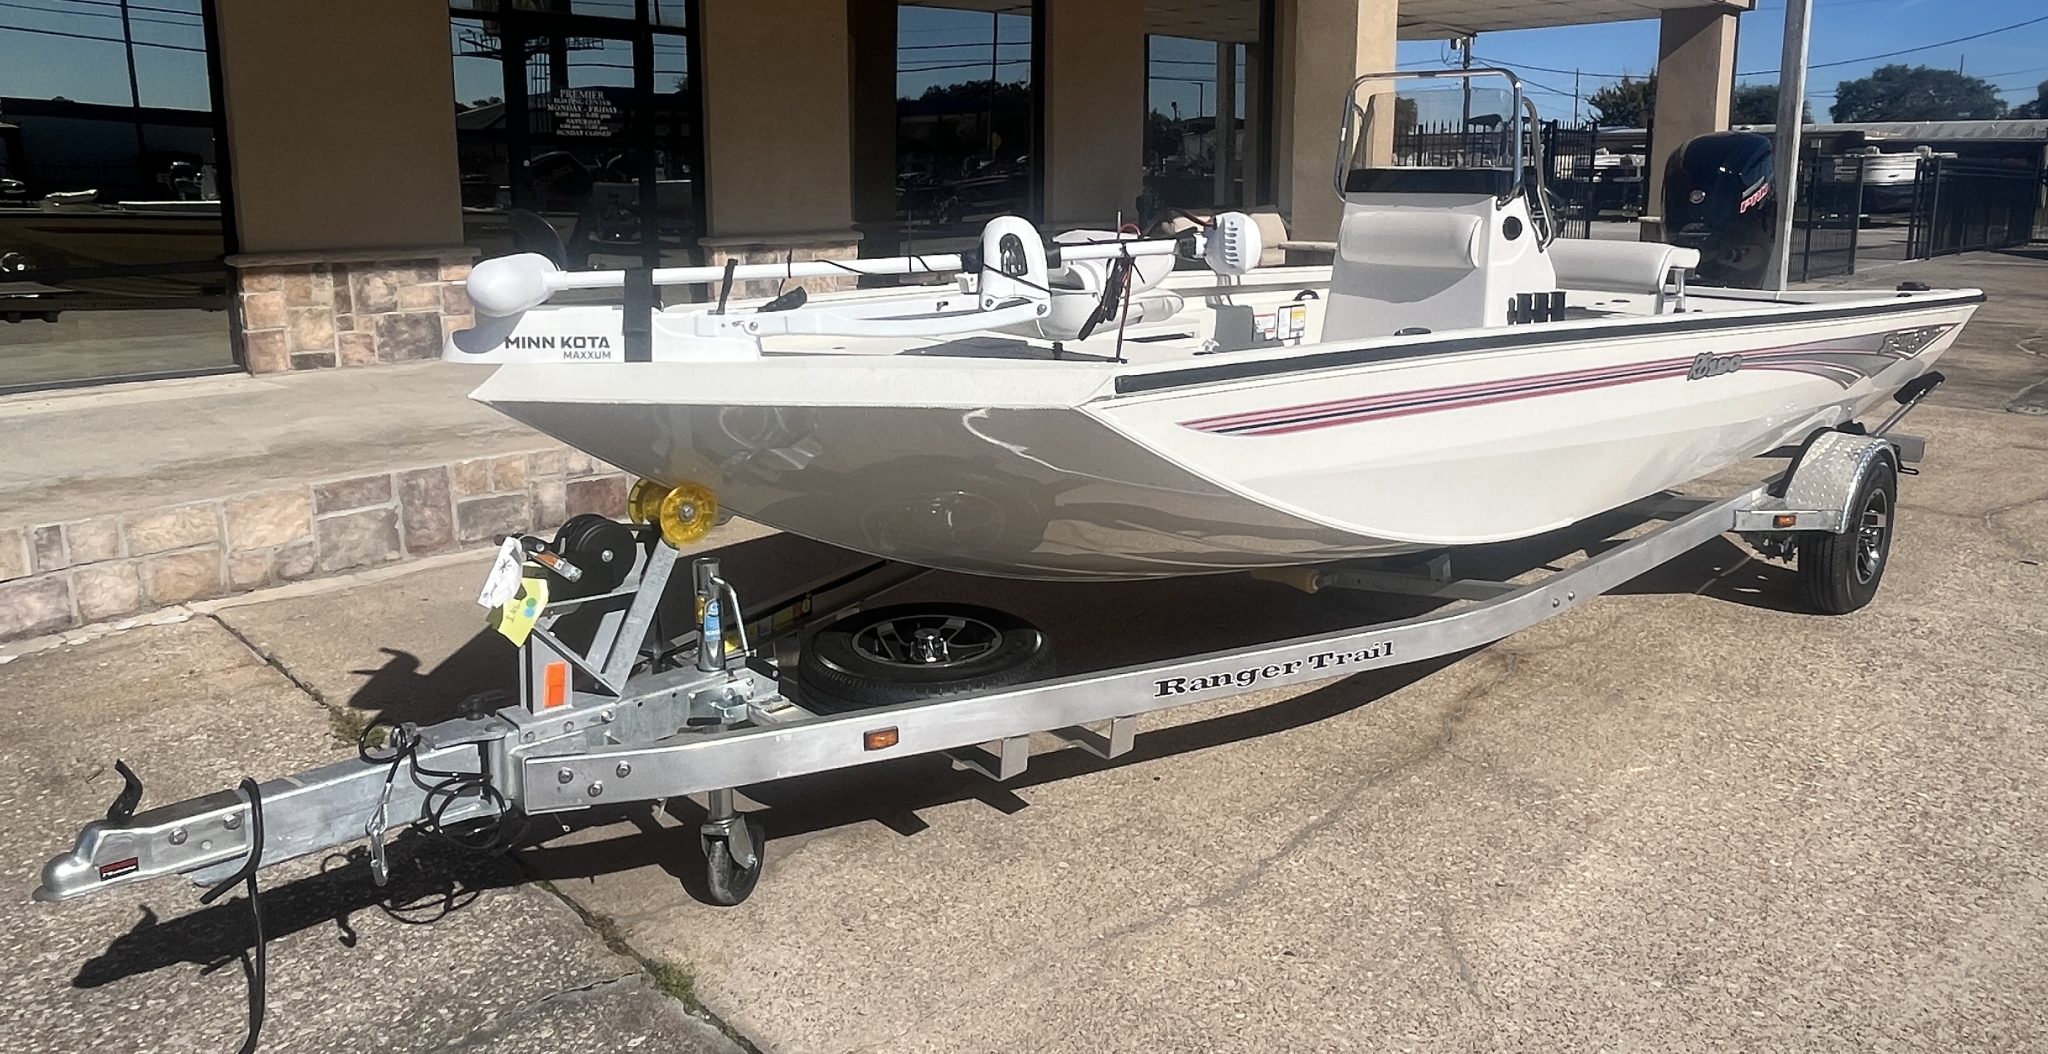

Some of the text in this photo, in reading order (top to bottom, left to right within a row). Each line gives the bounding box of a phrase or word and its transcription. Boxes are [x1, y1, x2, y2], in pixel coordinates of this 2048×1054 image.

[560, 89, 604, 99] PREMIER
[547, 104, 581, 112] MONDAY
[588, 105, 617, 113] FRIDAY
[504, 336, 610, 349] MINN KOTA
[563, 351, 611, 360] MAXXUM
[1153, 642, 1395, 698] Ranger Trail
